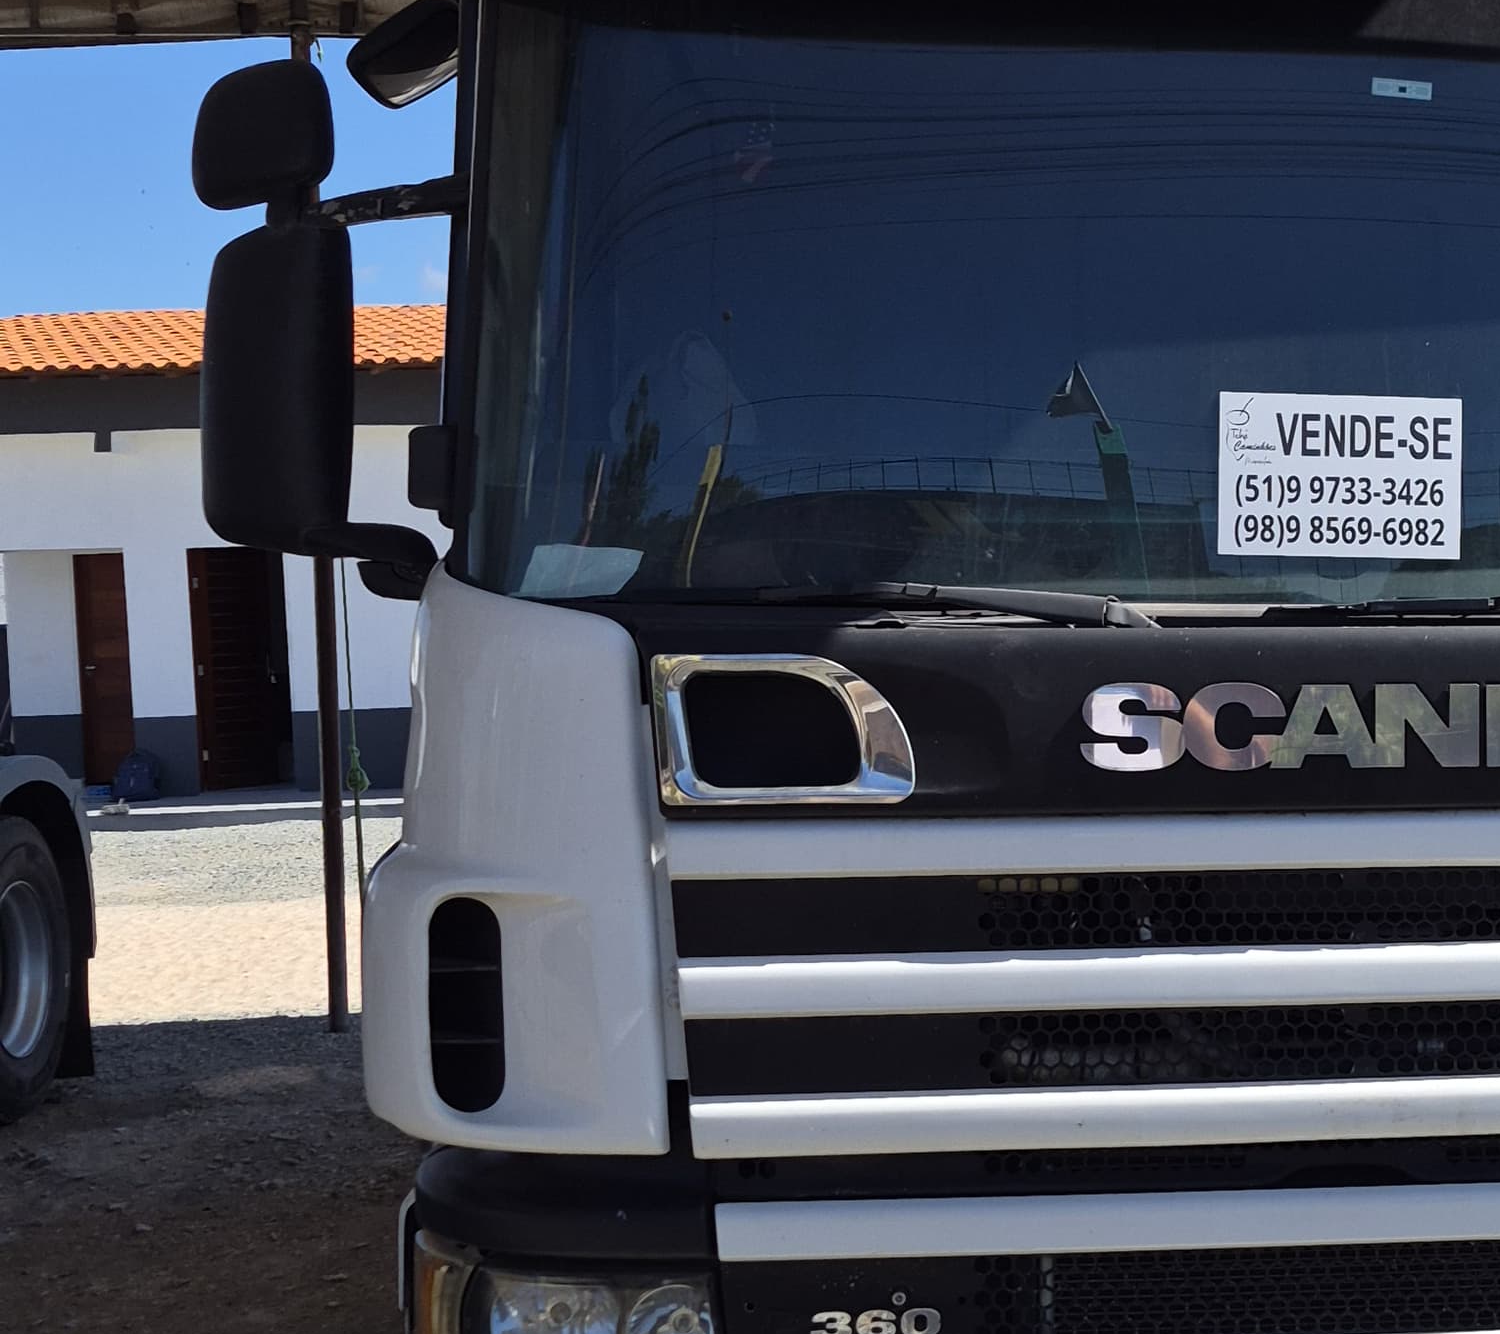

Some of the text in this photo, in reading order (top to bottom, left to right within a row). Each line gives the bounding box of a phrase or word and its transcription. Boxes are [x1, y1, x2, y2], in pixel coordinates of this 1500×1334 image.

[1276, 412, 1452, 460] VENDE-SE
[1235, 474, 1444, 508] (51)9 9733-3426
[1234, 514, 1445, 547] (98)9 8569-6982
